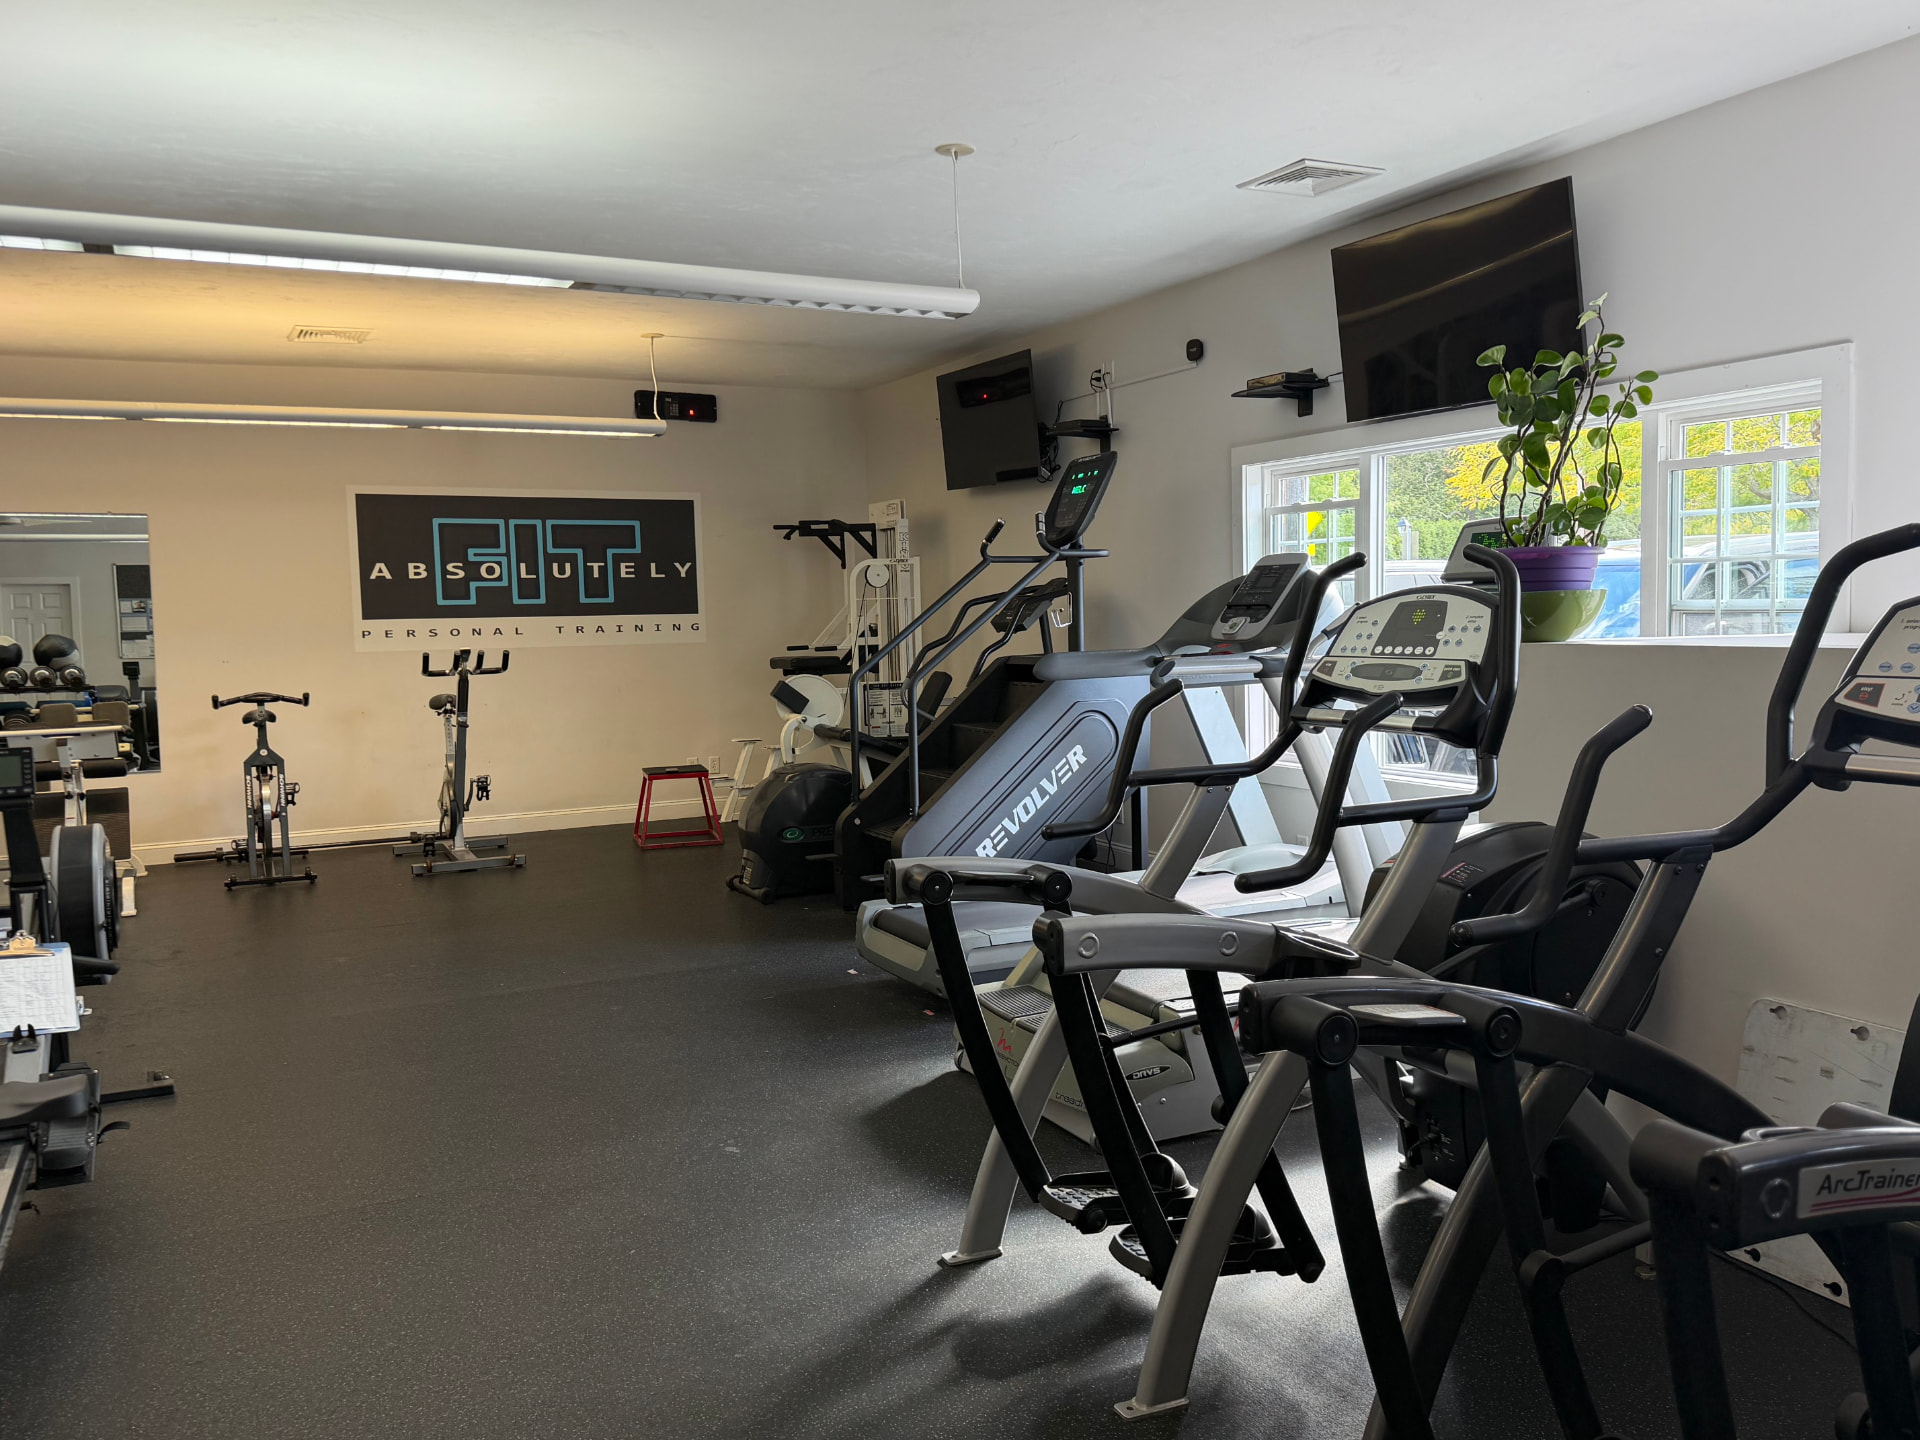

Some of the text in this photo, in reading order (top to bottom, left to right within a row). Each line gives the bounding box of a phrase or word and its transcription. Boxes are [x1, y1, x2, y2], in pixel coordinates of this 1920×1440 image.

[432, 518, 641, 605] FIT
[369, 562, 692, 580] ABSOLUTELY
[362, 622, 700, 639] PERSONAL TRAINING
[975, 744, 1088, 858] REVOLVER
[812, 825, 832, 837] PRE
